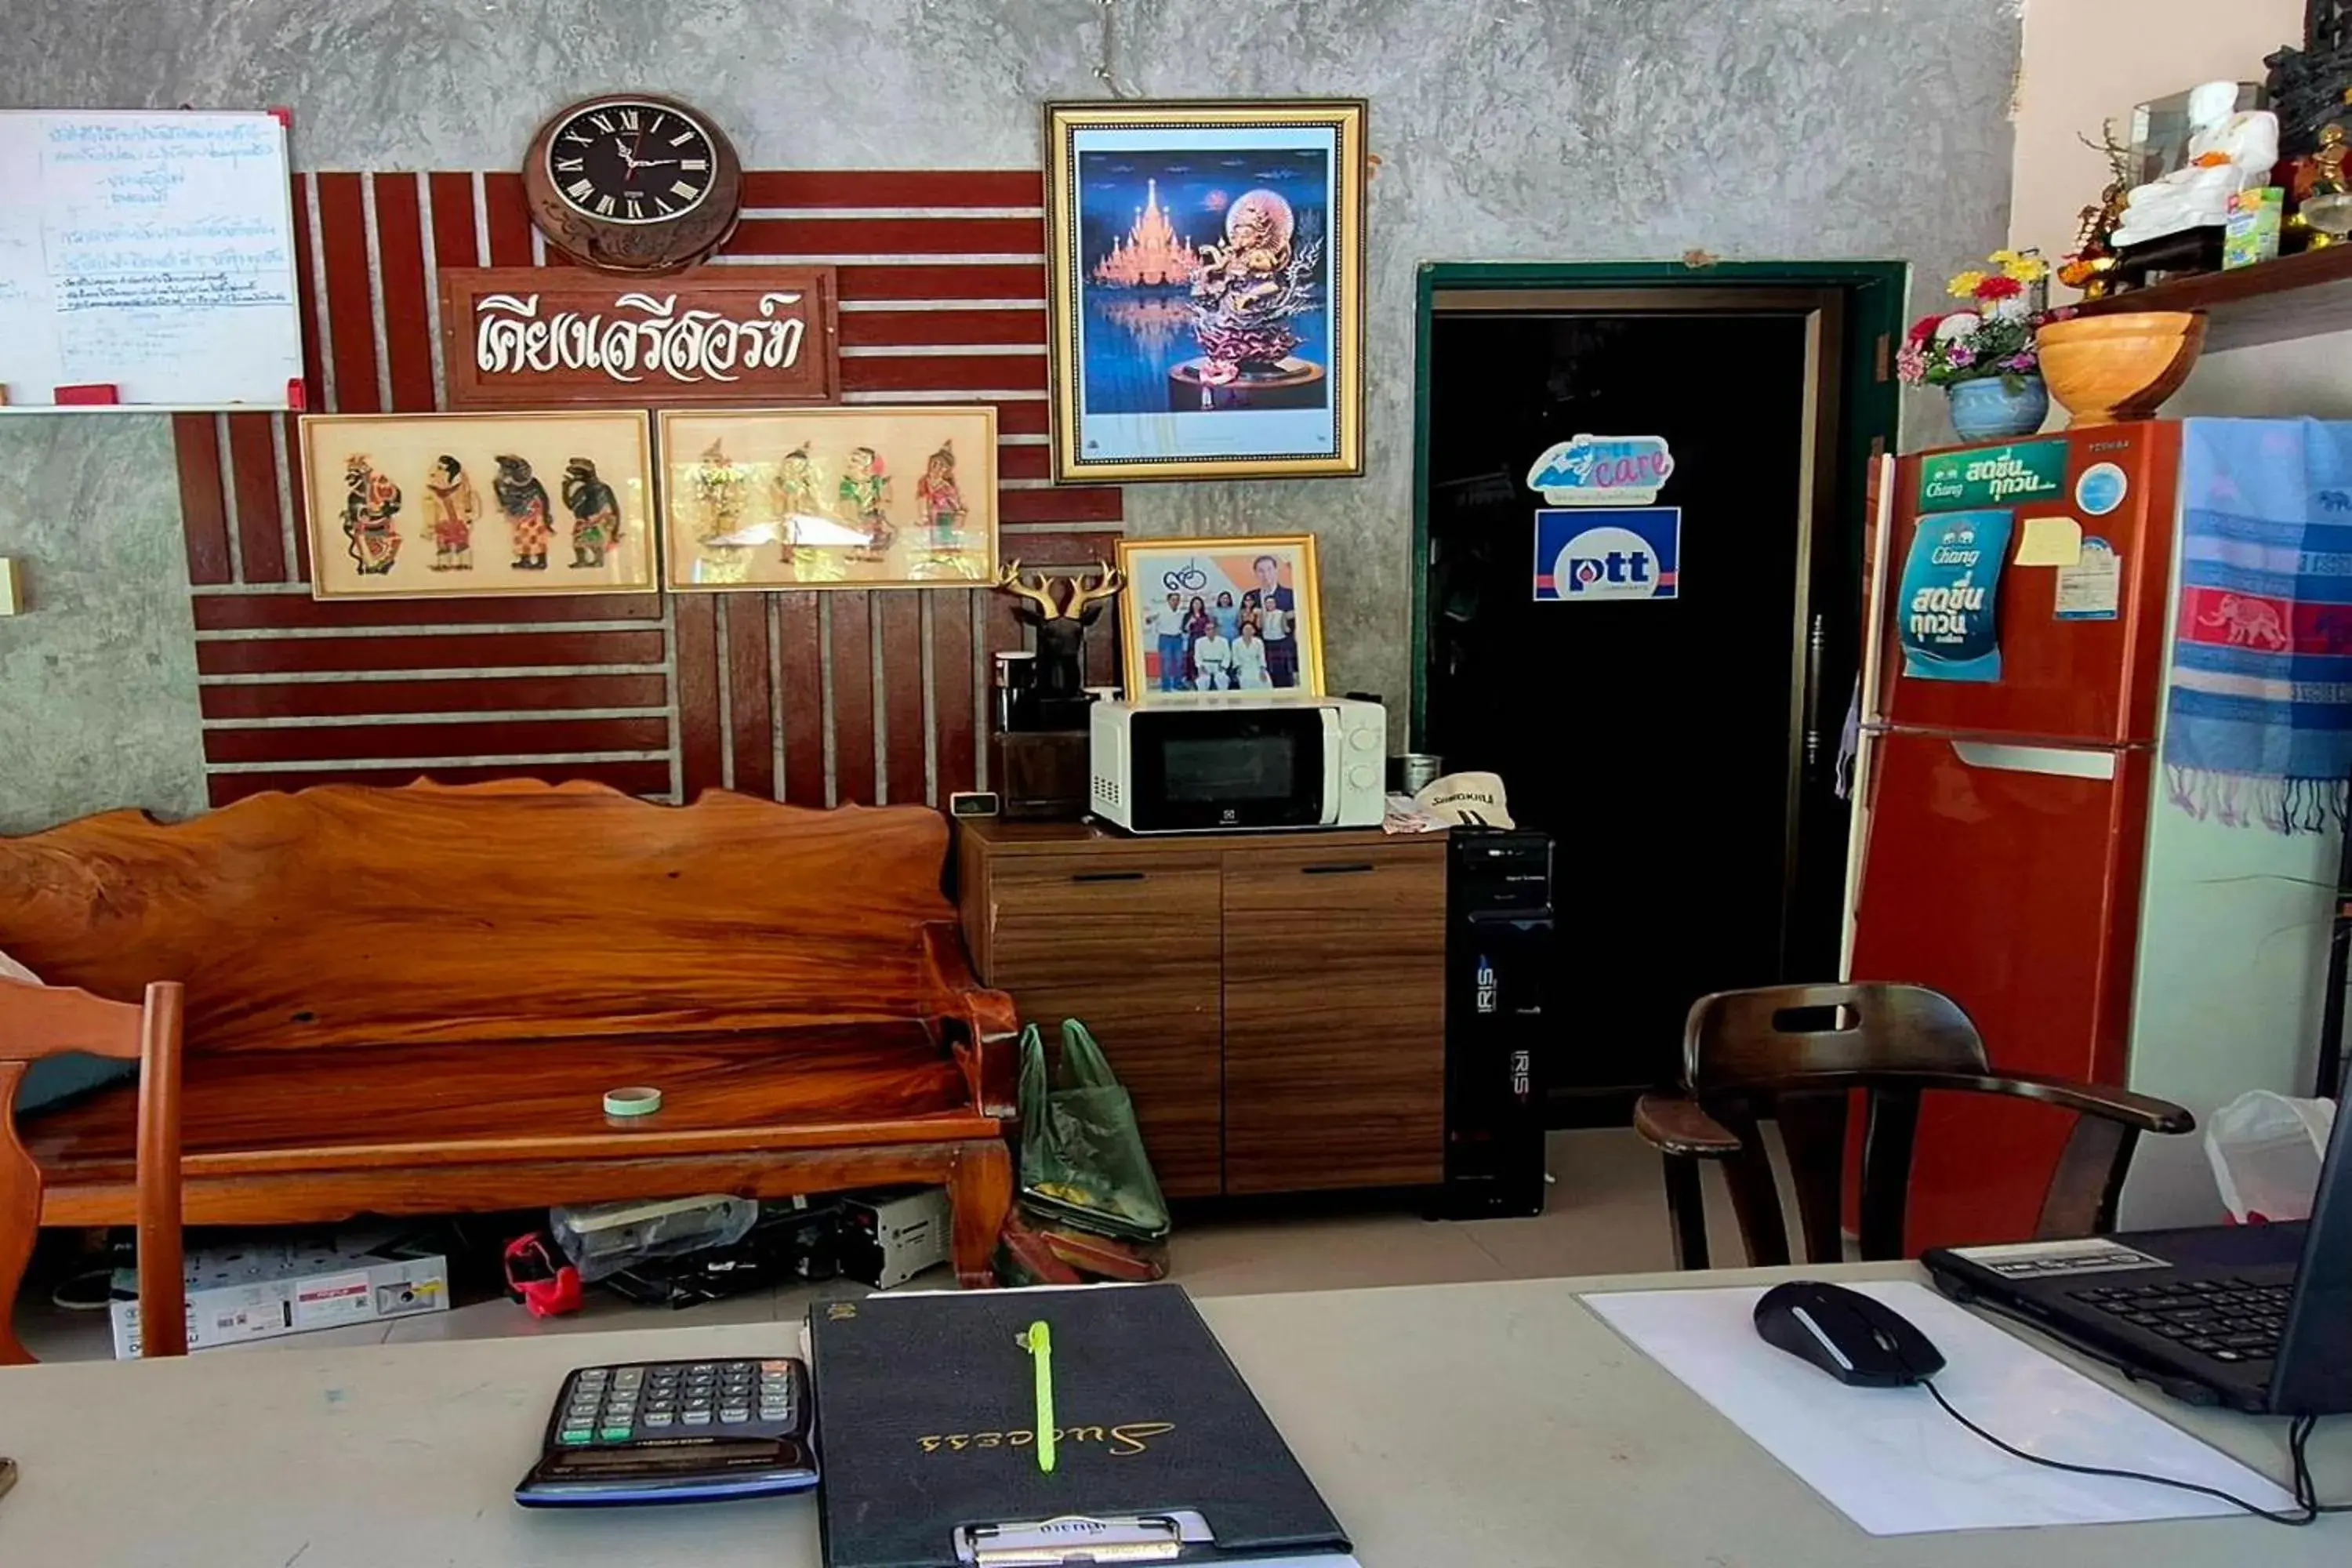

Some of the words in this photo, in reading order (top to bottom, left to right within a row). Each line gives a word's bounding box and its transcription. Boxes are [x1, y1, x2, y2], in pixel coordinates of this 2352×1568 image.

[590, 114, 615, 134] XI
[620, 109, 639, 131] XII
[650, 114, 665, 133] I
[563, 129, 593, 147] X
[669, 131, 696, 147] II
[680, 159, 706, 170] III
[655, 196, 674, 216] V
[1926, 481, 1964, 499] Chang
[1931, 546, 1981, 568] Chang
[1569, 551, 1650, 592] ptt
[1911, 569, 1986, 613] สดชื่น
[1476, 967, 1494, 1014] IRIS
[1514, 1049, 1530, 1095] IRIS
